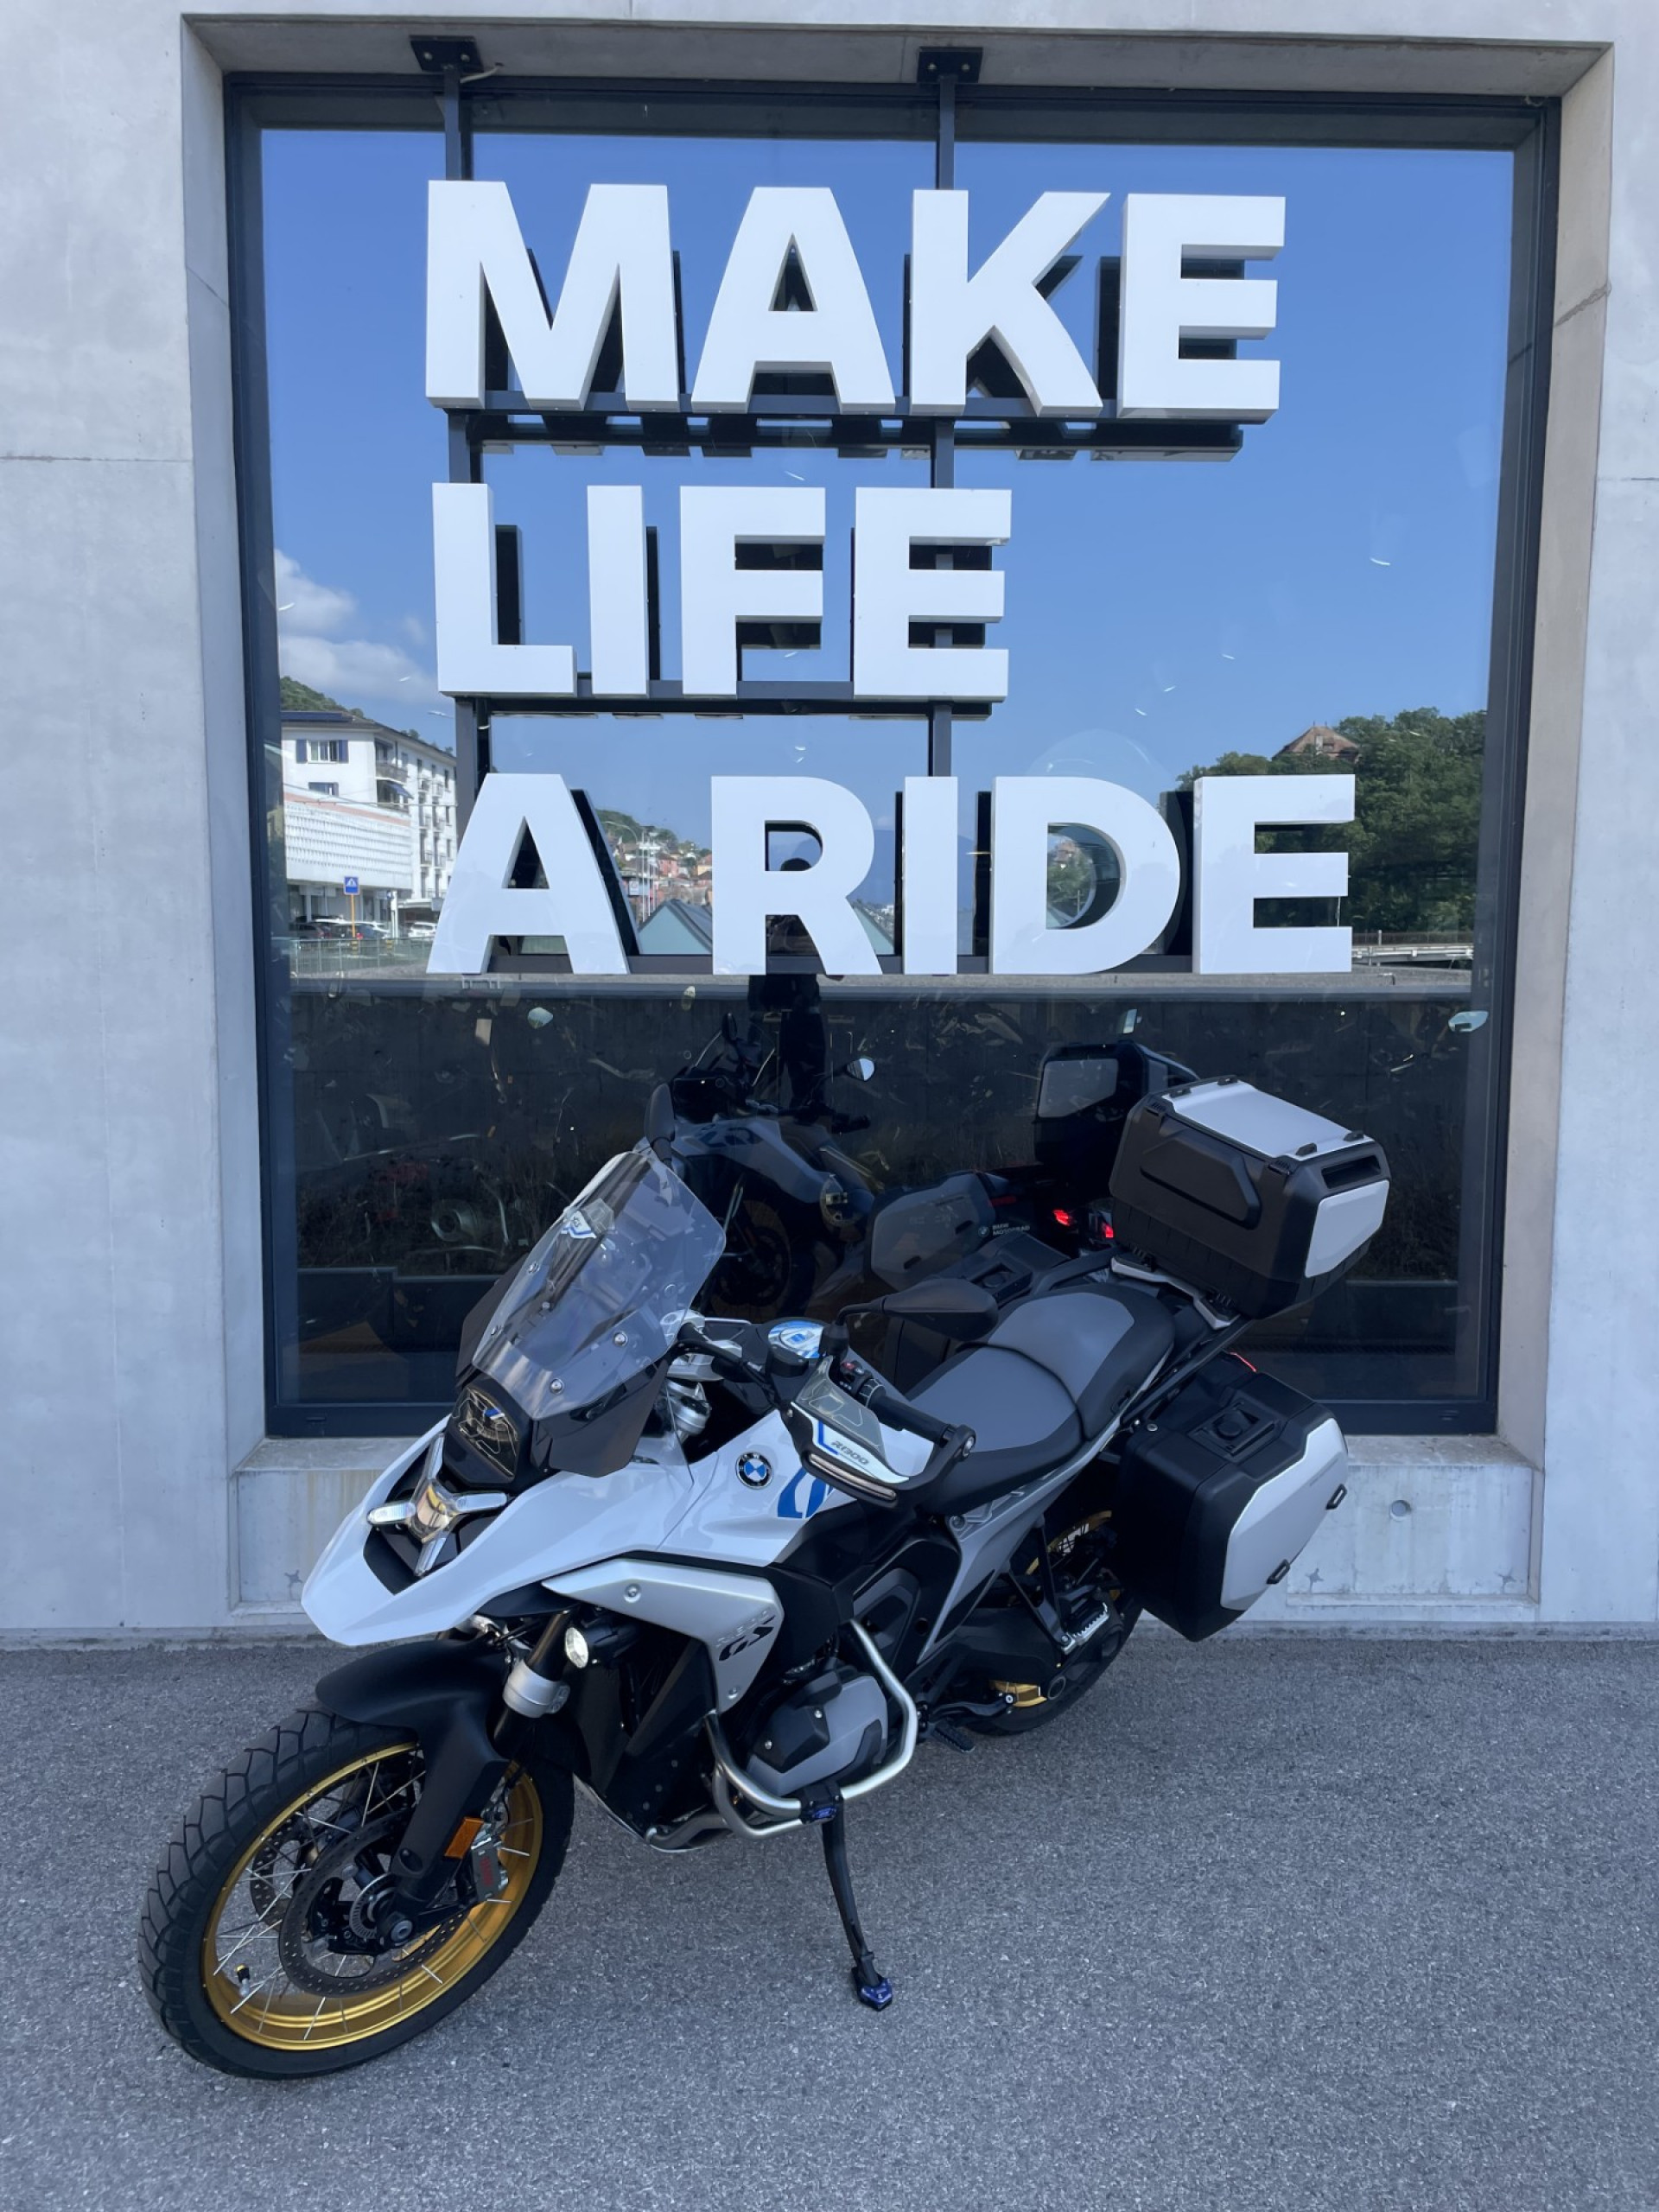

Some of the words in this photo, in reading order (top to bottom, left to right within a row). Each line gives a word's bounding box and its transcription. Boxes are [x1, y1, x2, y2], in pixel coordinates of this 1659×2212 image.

[426, 180, 1286, 418] MAKE
[432, 483, 1012, 701] LIFE
[426, 773, 629, 975] A
[711, 773, 1356, 976] RIDE
[718, 1614, 776, 1662] GS
